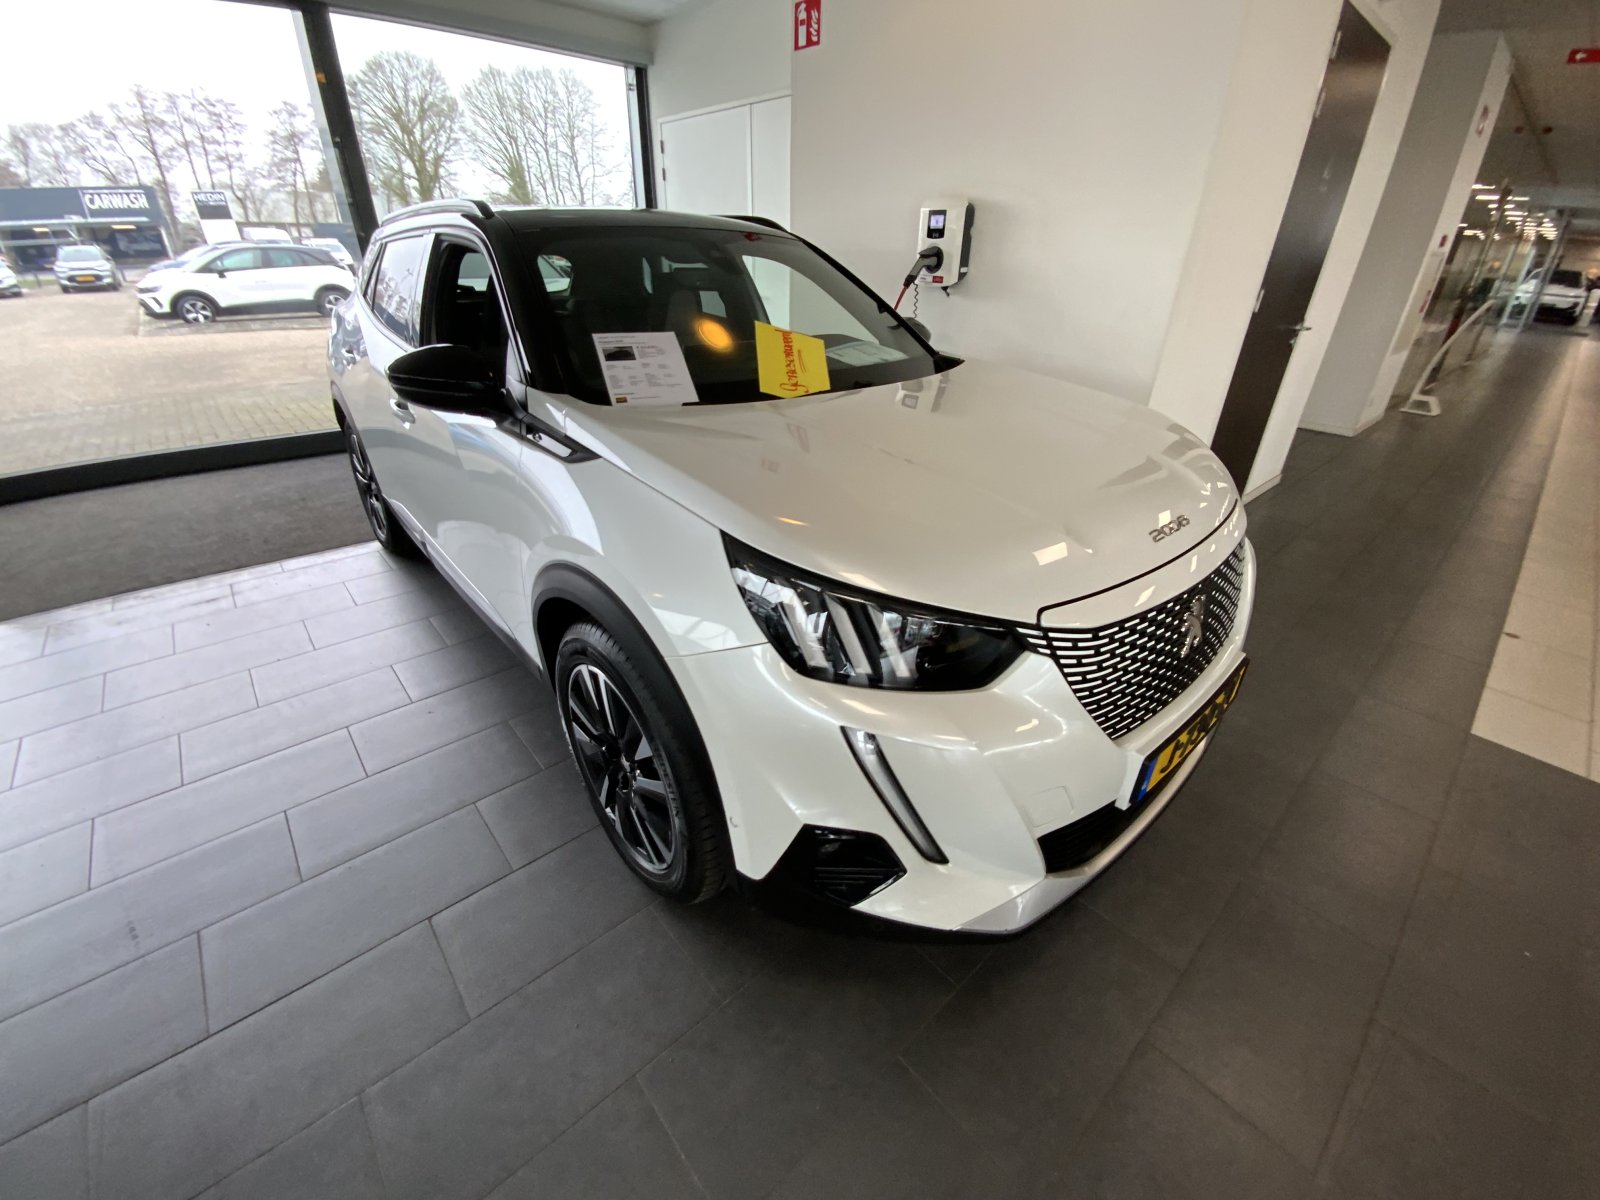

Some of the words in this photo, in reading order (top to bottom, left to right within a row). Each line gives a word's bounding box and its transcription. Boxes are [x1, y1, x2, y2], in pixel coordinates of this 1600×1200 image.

[84, 192, 149, 209] CARWASH
[192, 192, 226, 201] HEDIN
[1149, 515, 1191, 543] 2008
